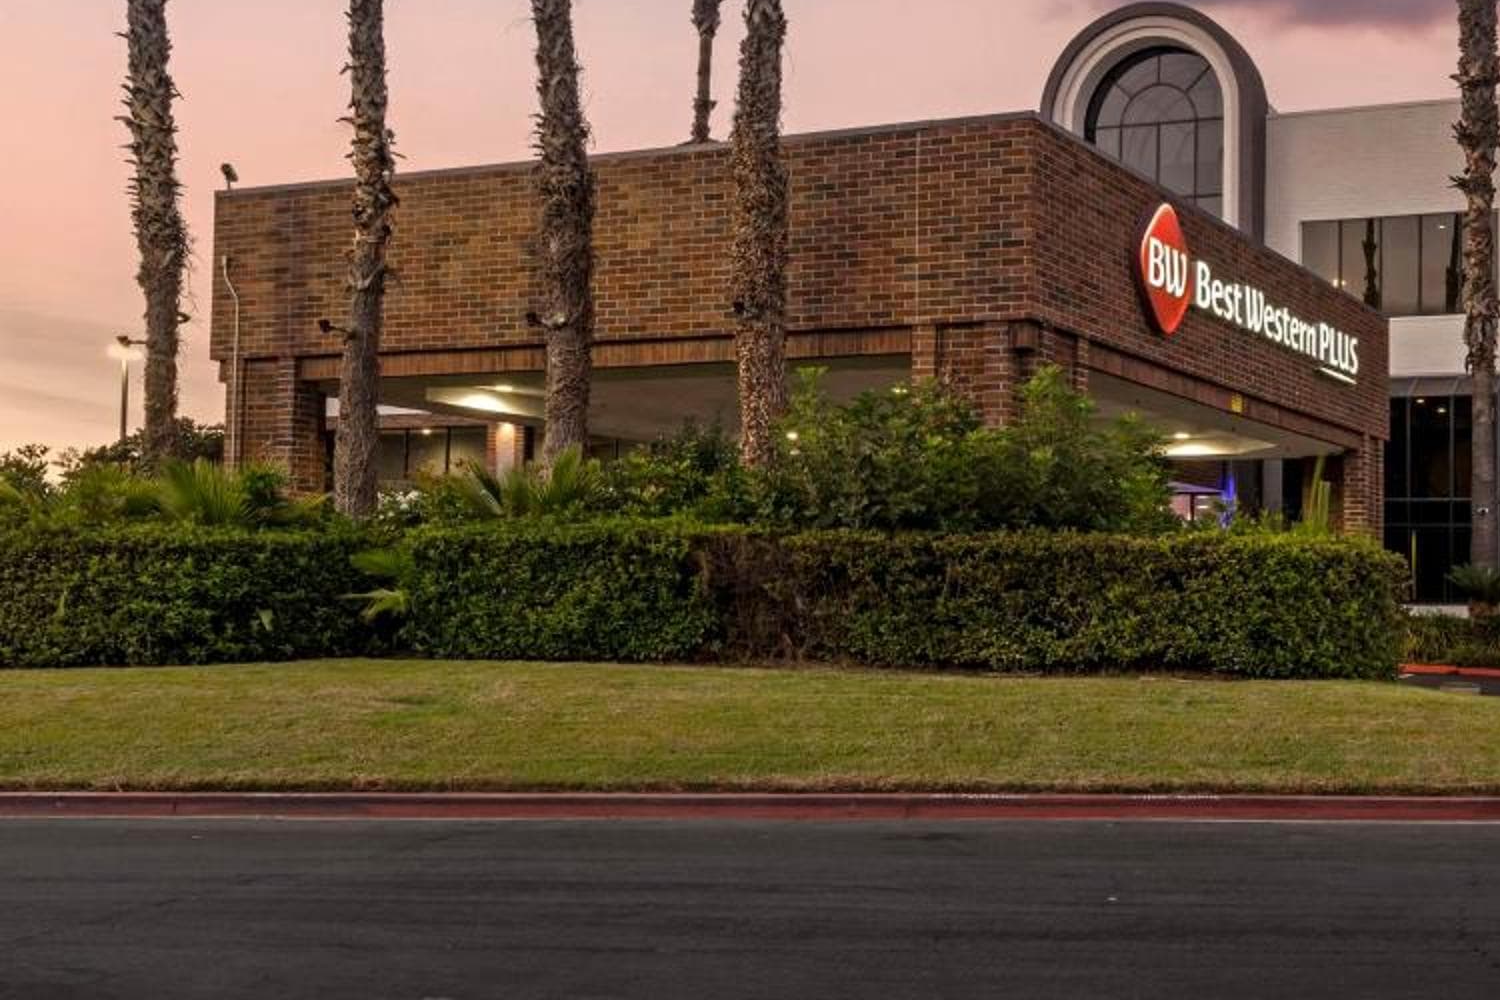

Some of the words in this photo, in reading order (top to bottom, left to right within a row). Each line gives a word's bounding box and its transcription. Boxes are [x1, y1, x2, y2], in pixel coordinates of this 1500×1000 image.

[1149, 235, 1187, 297] BW
[1196, 260, 1243, 325] Best
[1244, 285, 1317, 357] Western
[1319, 322, 1359, 375] PLUS
